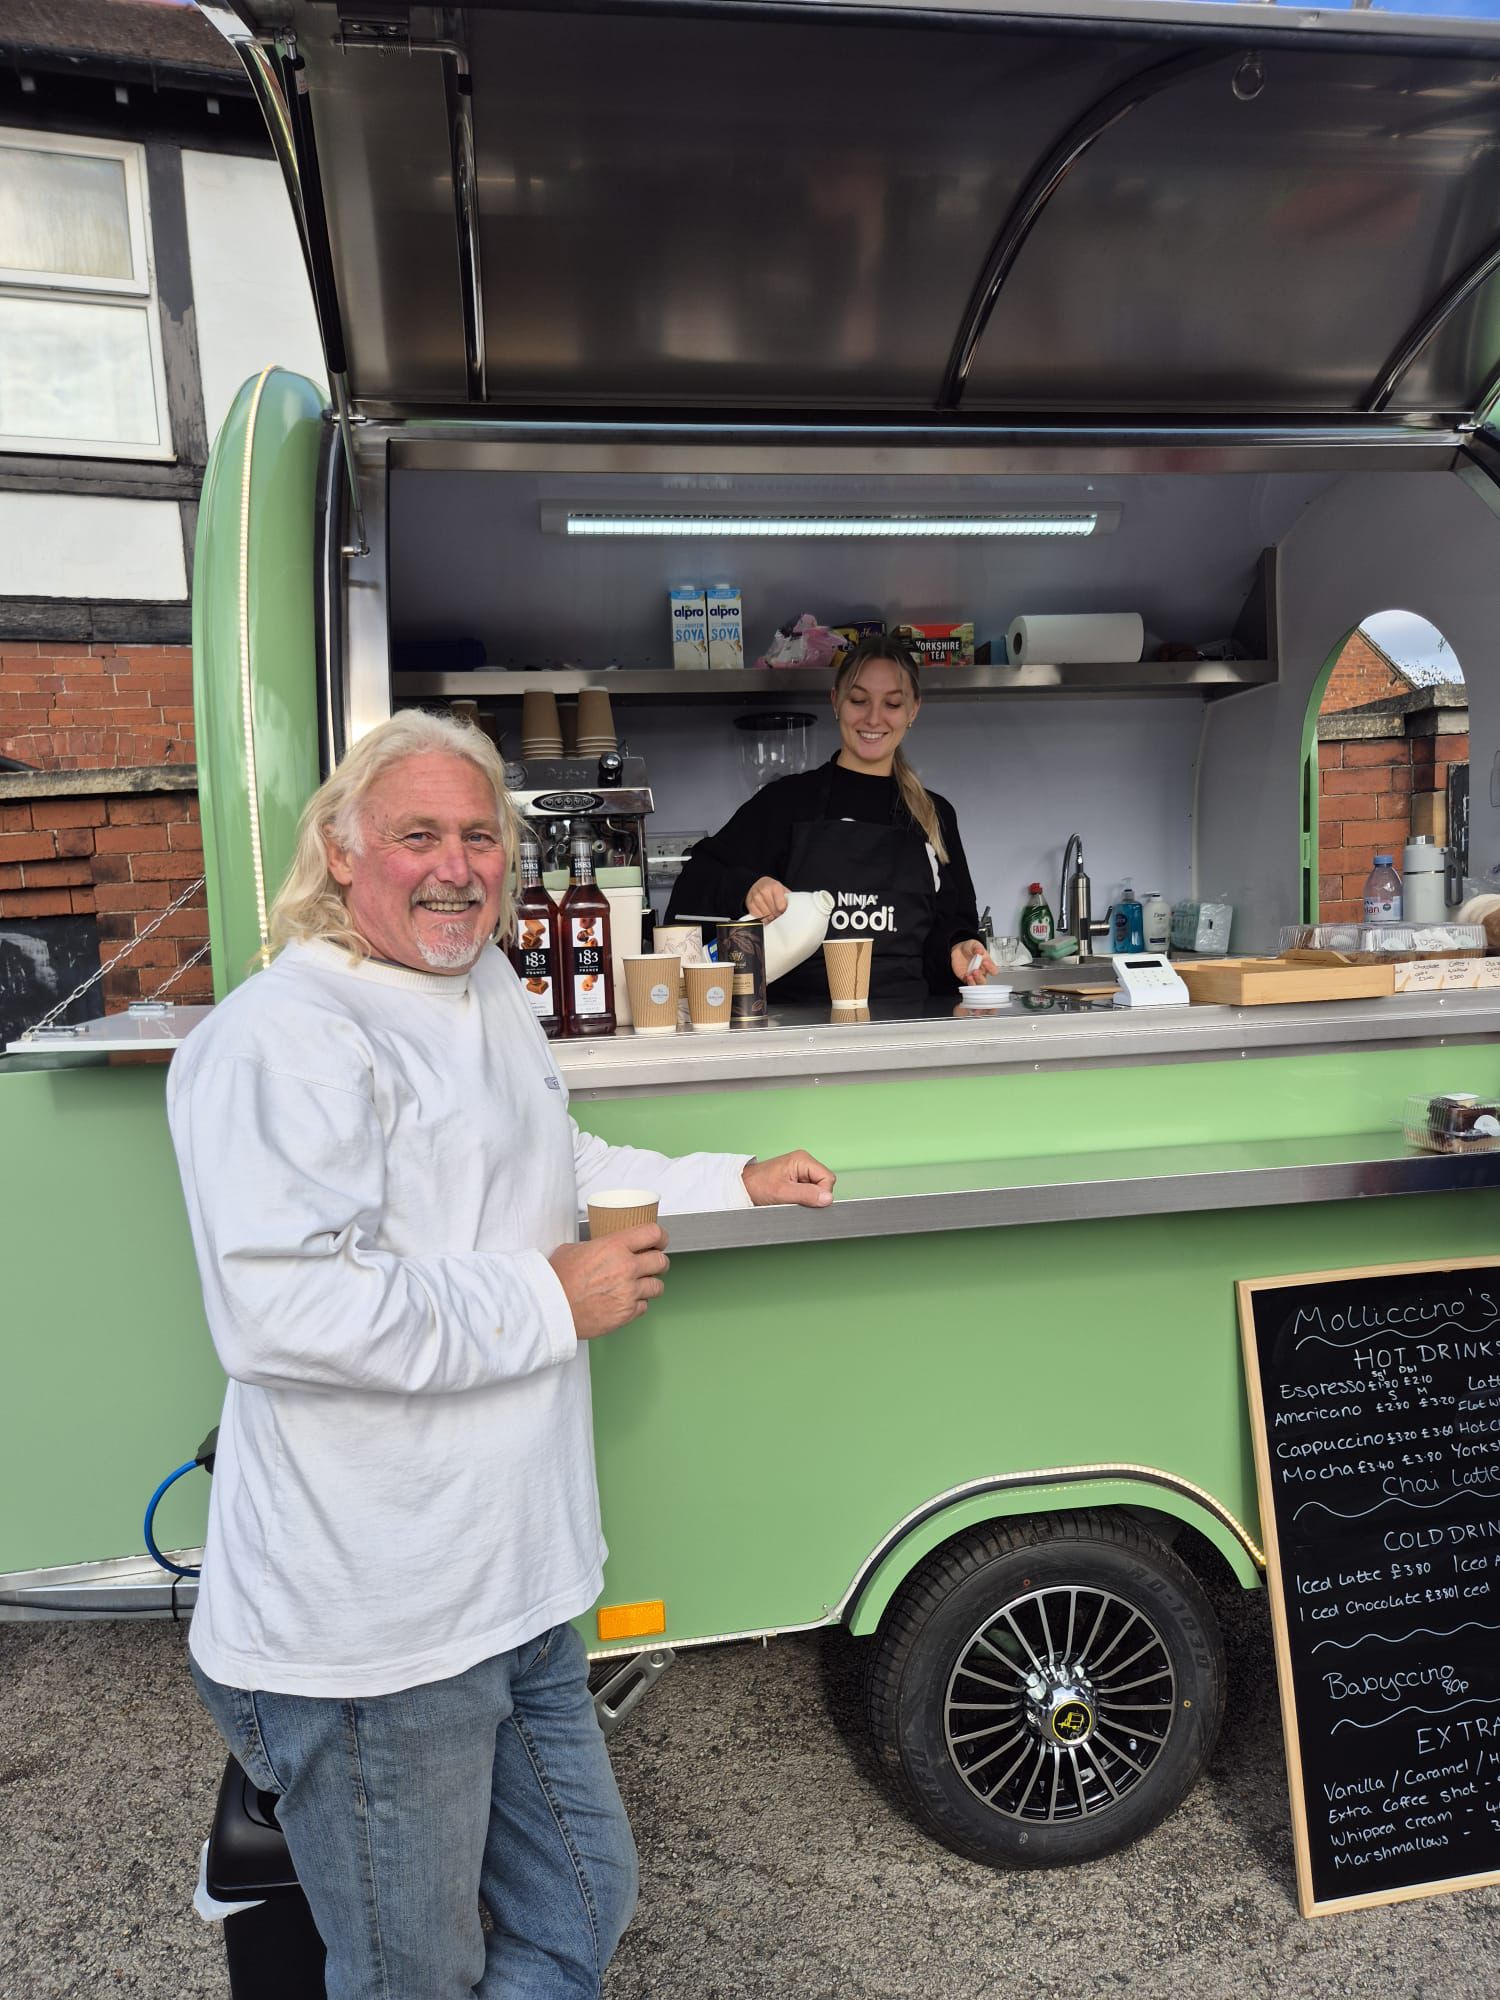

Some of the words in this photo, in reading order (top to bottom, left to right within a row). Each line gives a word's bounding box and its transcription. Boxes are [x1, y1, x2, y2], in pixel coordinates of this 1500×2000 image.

[674, 605, 704, 620] alpro
[710, 604, 740, 619] alpro
[675, 628, 705, 641] SOYA
[711, 627, 740, 641] SOYA
[915, 640, 960, 652] YORKSHIRE
[930, 651, 945, 660] TEA
[837, 891, 877, 909] NINJA
[831, 905, 895, 932] oodi
[1032, 924, 1048, 934] FAIRY
[578, 949, 599, 965] 1883
[1353, 1347, 1406, 1370] HOT
[1280, 1380, 1366, 1399] Espresso
[1388, 1390, 1398, 1401] S
[1417, 1387, 1428, 1395] M
[1275, 1405, 1362, 1427] Americano
[1277, 1432, 1384, 1459] Cappuccino
[1460, 1420, 1487, 1434] Hot
[1282, 1463, 1355, 1483] Mocha
[1451, 1440, 1500, 1459] Yorks
[1382, 1471, 1440, 1496] Chai
[1452, 1465, 1500, 1487] Latte
[1384, 1528, 1443, 1551] COLD
[1297, 1574, 1333, 1594] Iced
[1339, 1569, 1383, 1586] Latte
[1453, 1554, 1488, 1573] Iced
[1300, 1604, 1339, 1622] Iced
[1345, 1592, 1422, 1615] Chocolate
[1322, 1662, 1454, 1702] Babyccino
[1442, 1678, 1469, 1696] 80p
[1323, 1777, 1386, 1802] Vanilla
[1404, 1758, 1470, 1785] Caramel
[1328, 1805, 1373, 1824] Extra
[1382, 1794, 1430, 1813] Coffee
[1330, 1822, 1397, 1847] Whipped
[1334, 1834, 1449, 1870] Marshmallows
